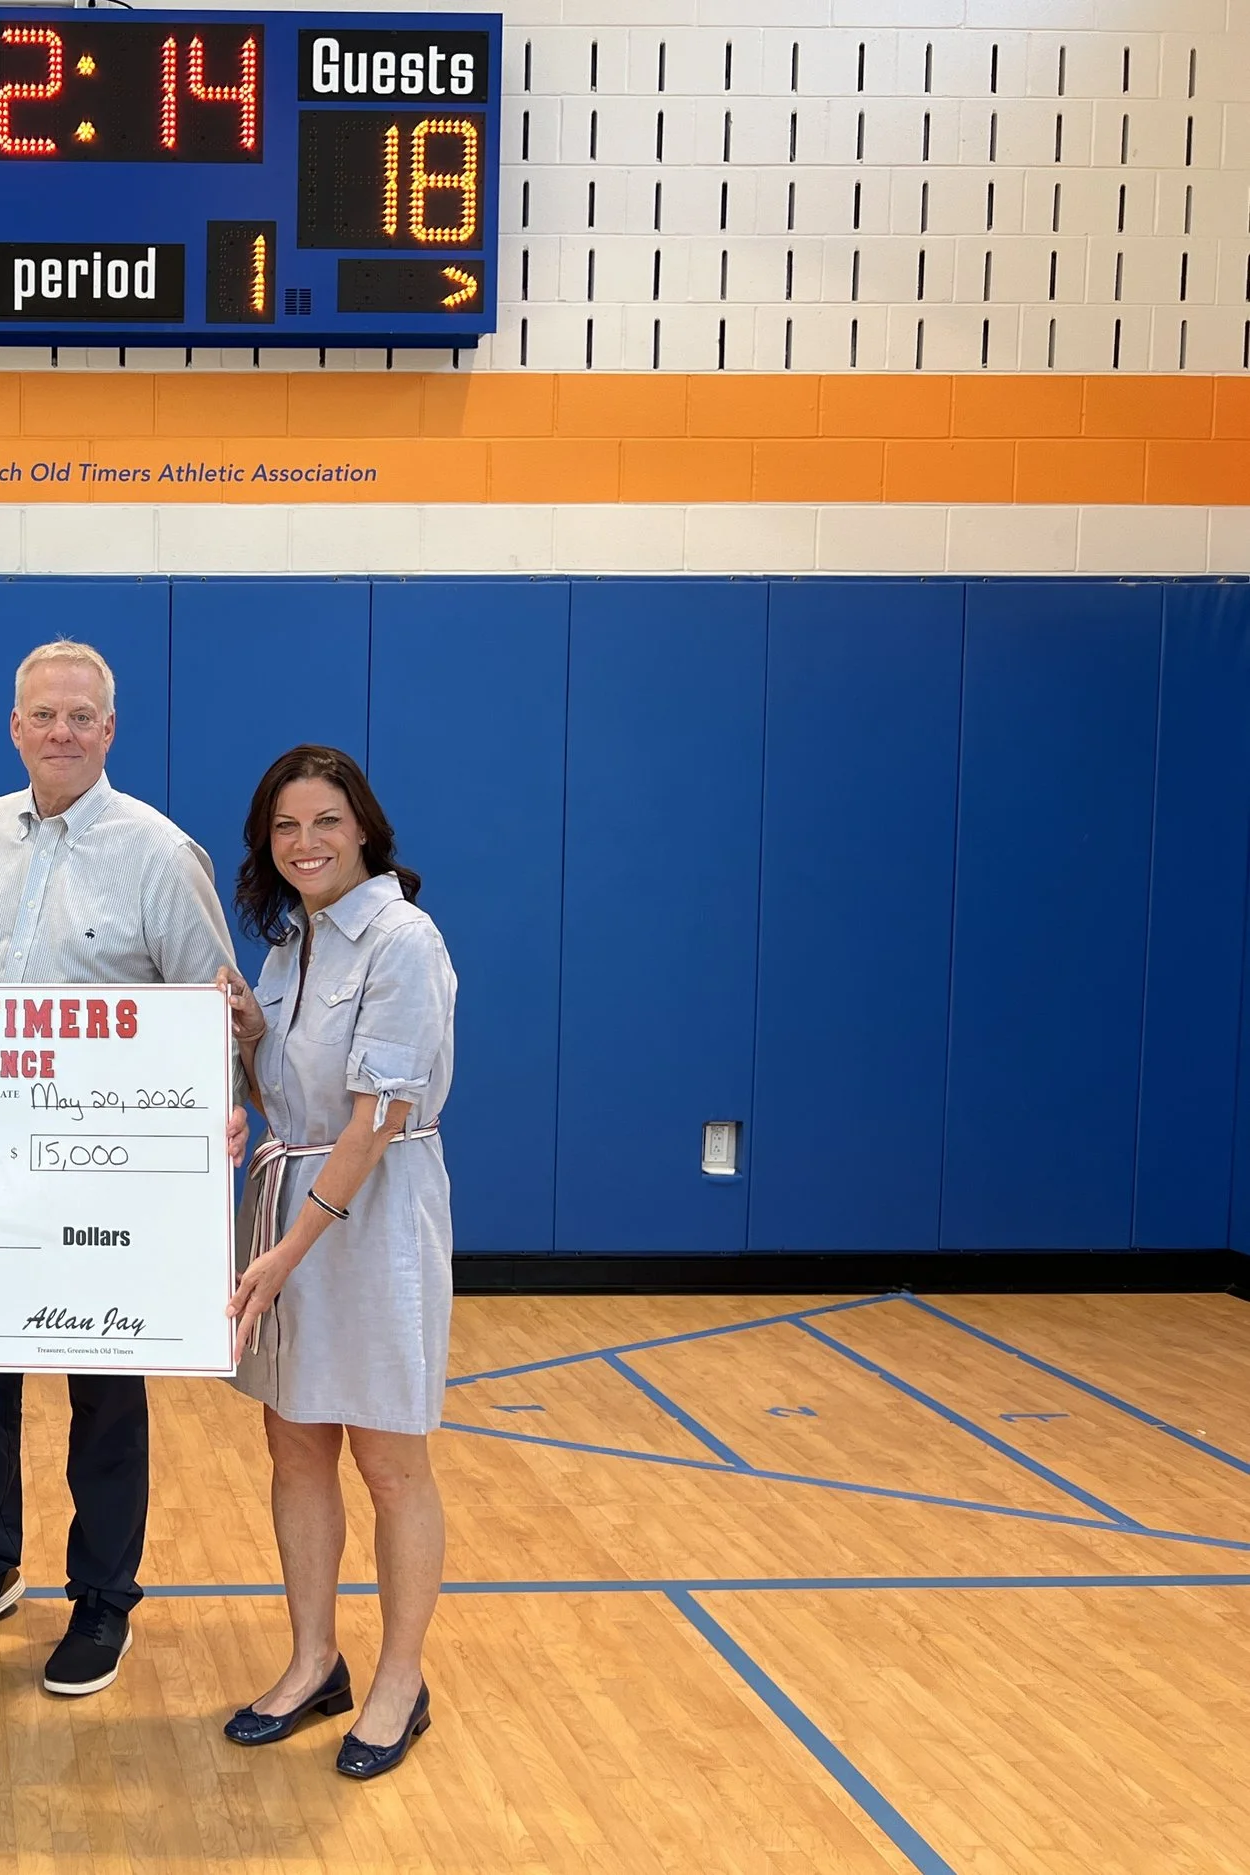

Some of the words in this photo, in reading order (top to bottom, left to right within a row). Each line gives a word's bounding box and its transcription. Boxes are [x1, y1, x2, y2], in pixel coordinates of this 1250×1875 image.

[313, 38, 473, 94] Guests
[382, 119, 479, 243] 18
[15, 248, 155, 310] period
[251, 231, 267, 314] 1
[31, 462, 71, 481] Old
[79, 464, 150, 481] Timers
[158, 463, 244, 482] Athletic
[251, 464, 377, 481] Association
[31, 1082, 84, 1121] May
[91, 1089, 126, 1114] 20,
[136, 1087, 196, 1110] 2026
[11, 1148, 17, 1159] $
[37, 1141, 129, 1171] 15,000
[63, 1227, 130, 1246] Dollars
[21, 1305, 96, 1331] Allan
[100, 1306, 147, 1337] Jay
